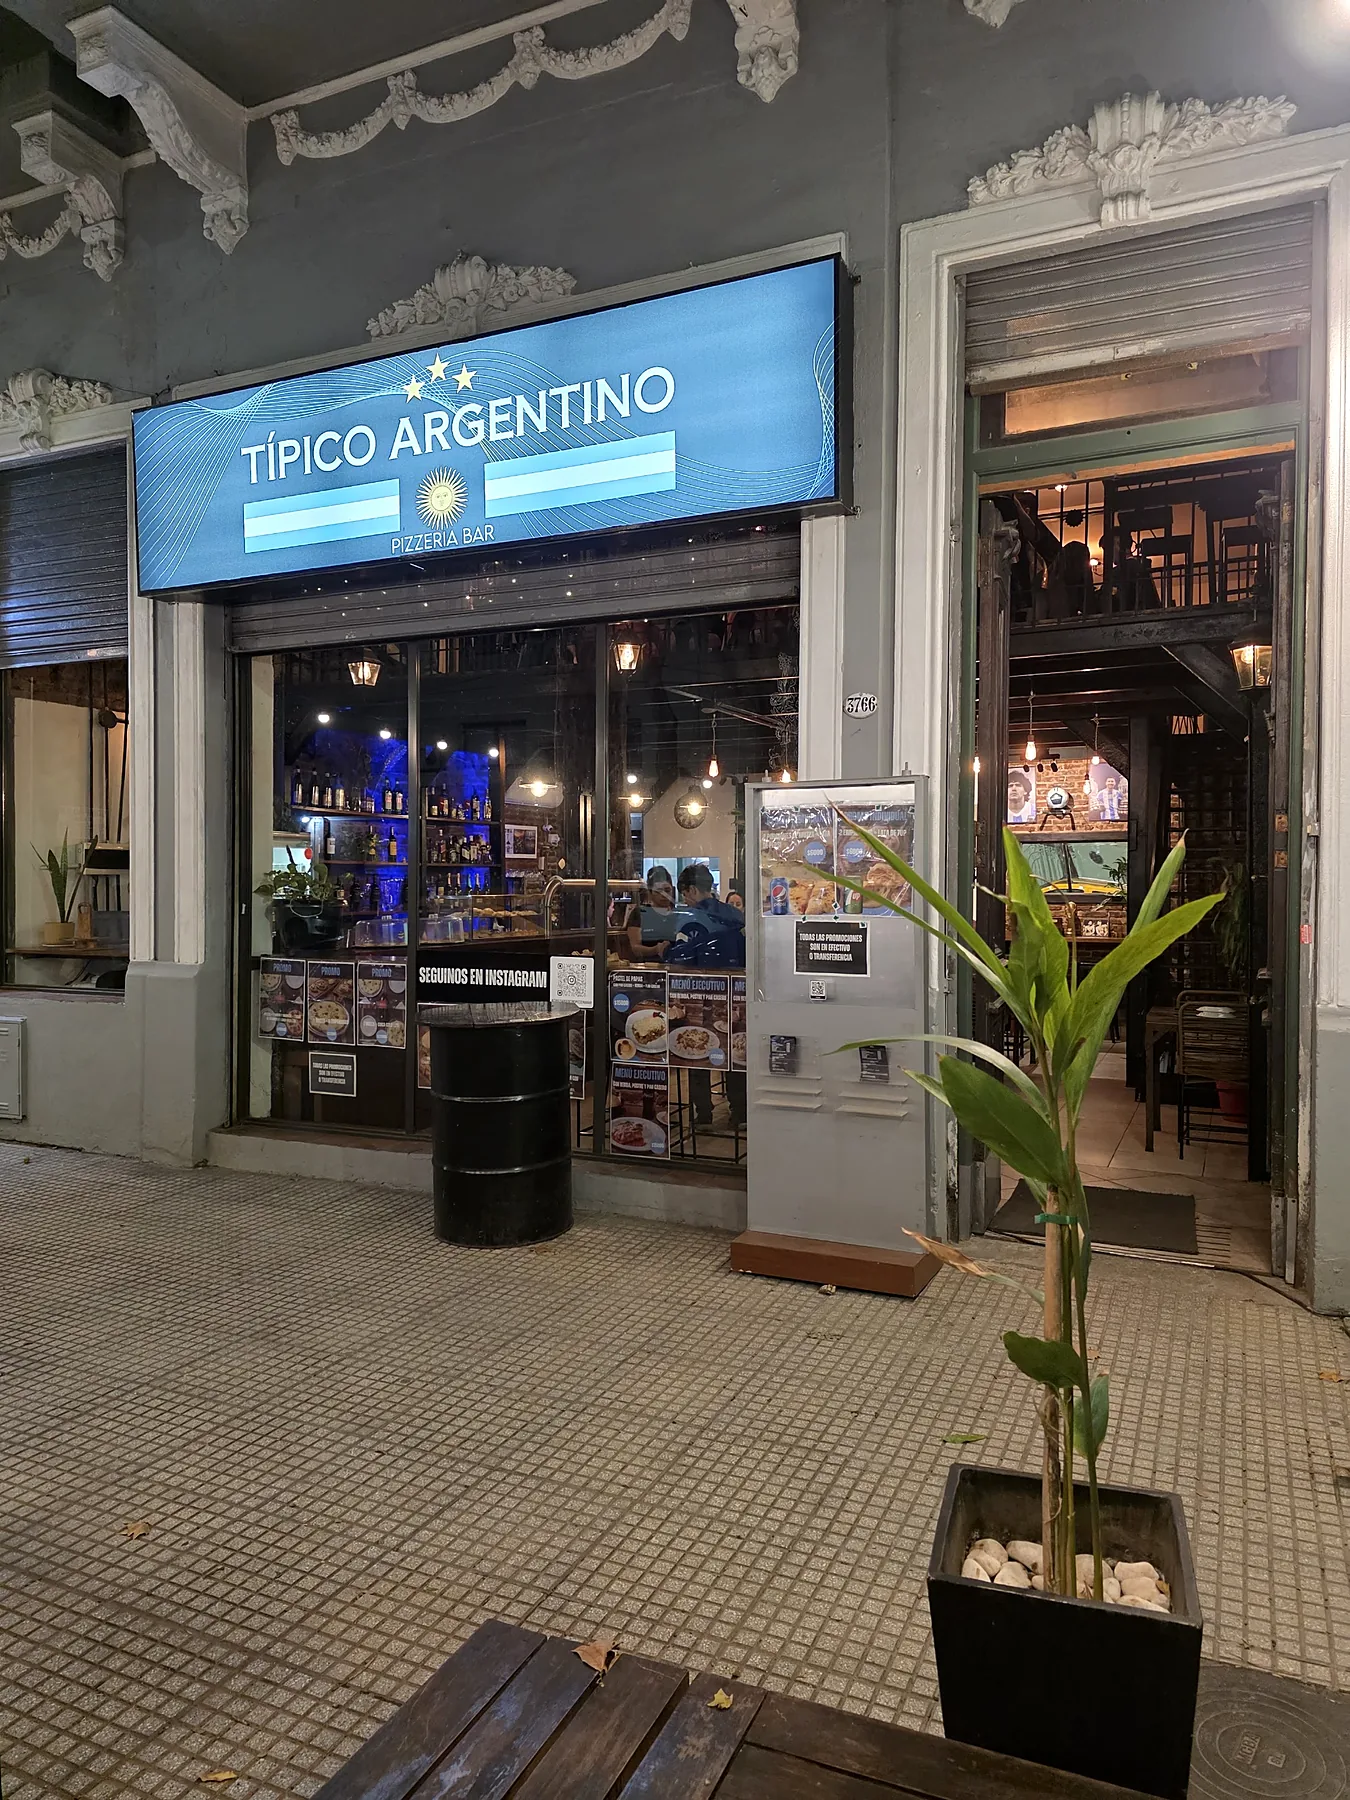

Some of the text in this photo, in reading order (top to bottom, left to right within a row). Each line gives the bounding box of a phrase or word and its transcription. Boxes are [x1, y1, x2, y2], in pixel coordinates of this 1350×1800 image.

[240, 366, 676, 484] TÍPICO ARGENTINO
[391, 524, 495, 555] PIZZERIA BAR
[847, 696, 876, 713] 3766
[799, 933, 815, 941] TODAS
[826, 934, 863, 943] PROMOCIONES
[810, 943, 851, 952] SON EN EFECTIVO
[814, 952, 853, 962] TRANSFERENCIA
[273, 962, 292, 973] PROMO
[321, 966, 341, 976] PROMO
[371, 968, 392, 978] PROMO
[419, 967, 547, 988] SEGUINOS EN INSTAGRAM
[692, 980, 725, 991] EJECUTIVO
[633, 1069, 666, 1081] EJECUTIVO
